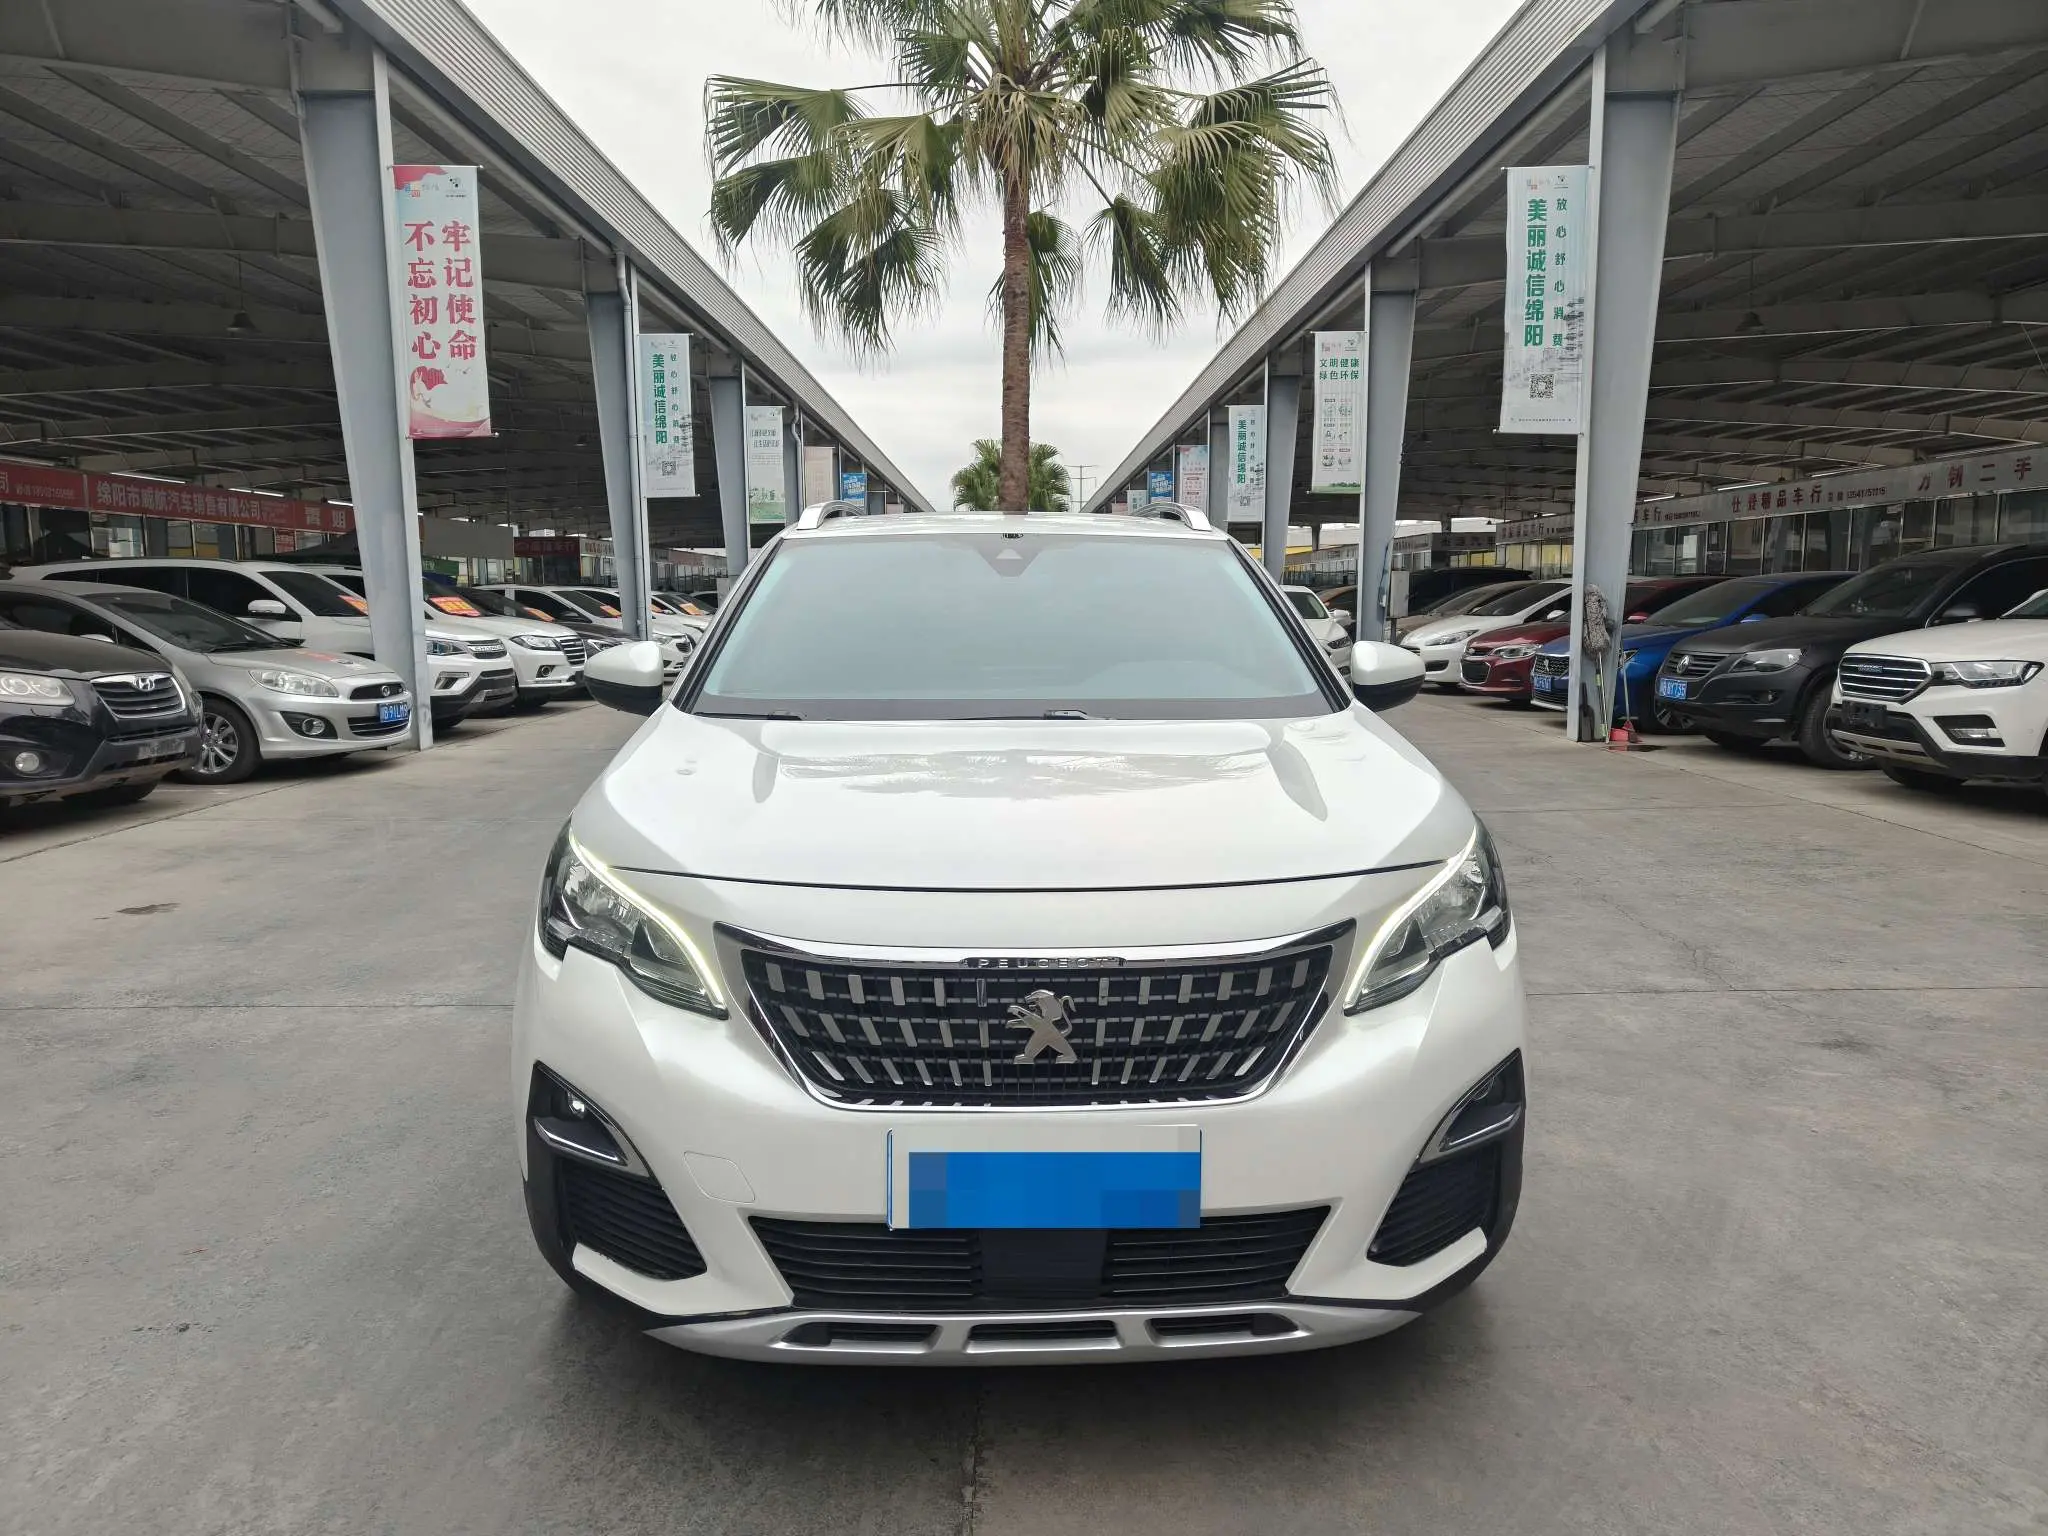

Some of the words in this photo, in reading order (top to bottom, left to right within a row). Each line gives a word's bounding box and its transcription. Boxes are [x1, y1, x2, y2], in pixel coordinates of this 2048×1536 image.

[404, 220, 441, 360] 不忘初心
[441, 220, 477, 361] 牢记使命
[1524, 198, 1548, 347] 美丽诚信绵阳
[1552, 198, 1568, 347] 放心舒心消费
[652, 353, 668, 445] 美丽诚信绵阳
[1319, 358, 1360, 368] 文明健康
[1319, 370, 1359, 380] 绿色环保
